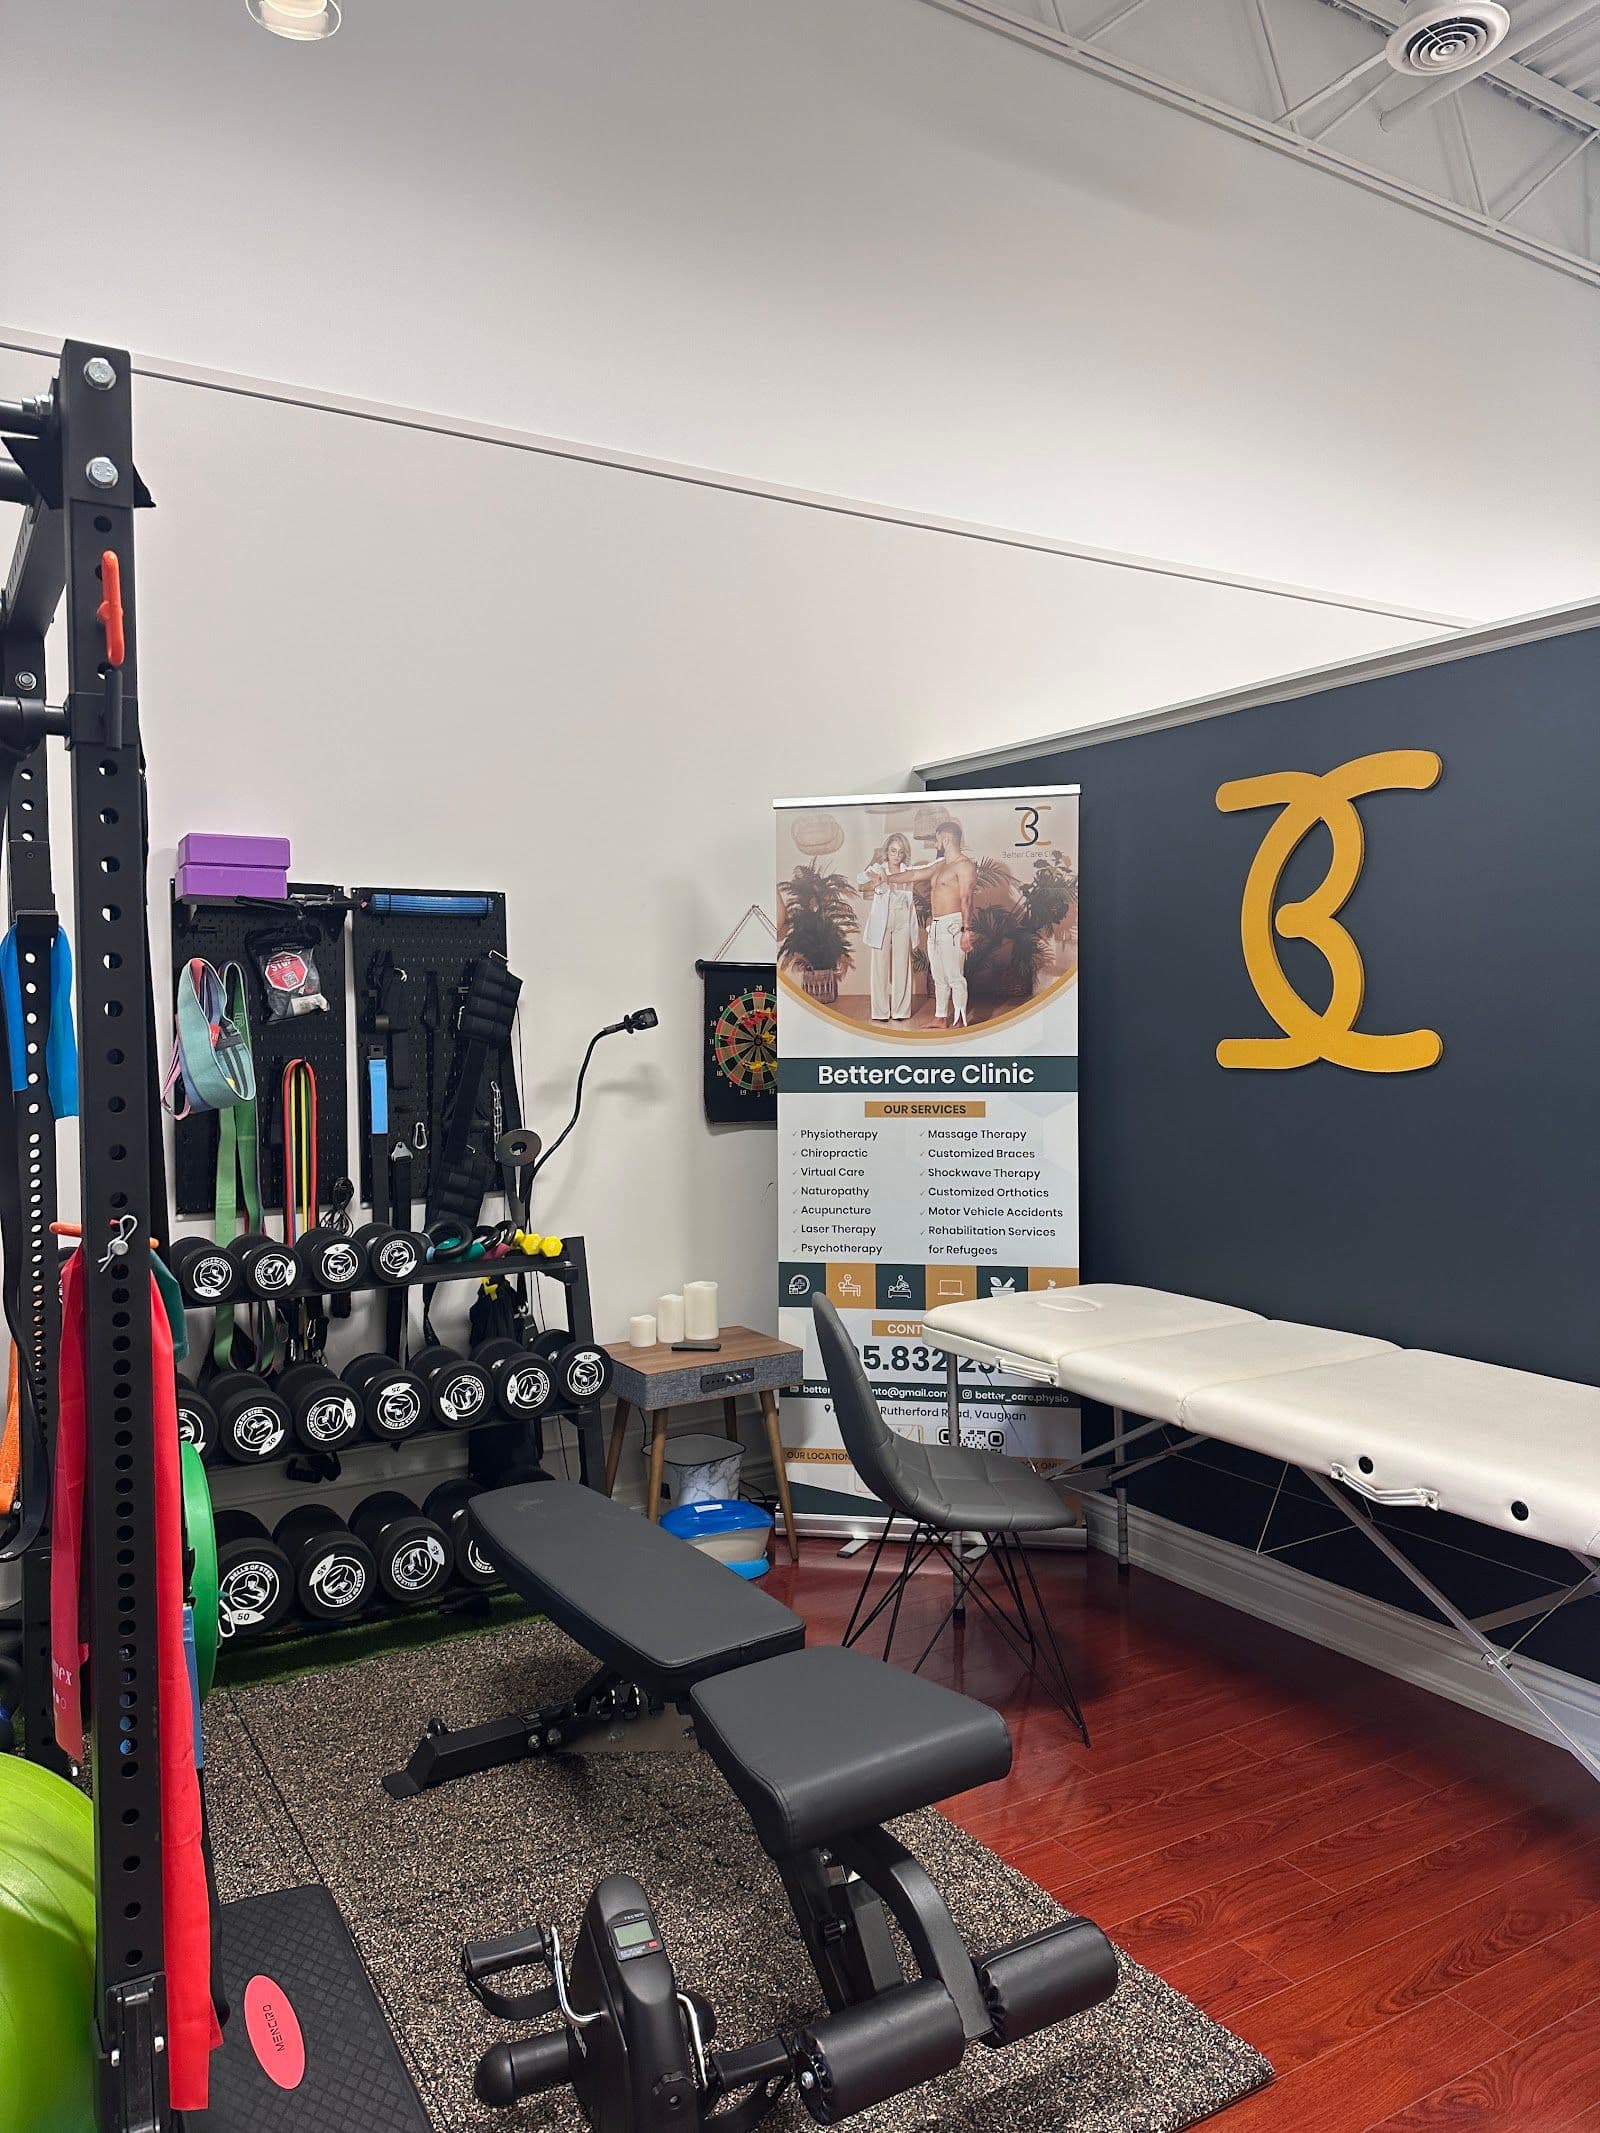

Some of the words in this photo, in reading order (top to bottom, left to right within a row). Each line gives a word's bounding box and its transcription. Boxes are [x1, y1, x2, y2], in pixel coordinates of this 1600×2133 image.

[818, 1064, 956, 1085] BetterCare
[962, 1062, 1035, 1084] Clinic
[883, 1104, 908, 1114] OUR
[911, 1104, 967, 1114] SERVICES
[800, 1129, 878, 1141] Physiotherapy
[928, 1129, 978, 1141] Massage
[980, 1129, 1027, 1141] Therapy
[800, 1148, 868, 1160] Chiropractic
[928, 1148, 994, 1158] Customized
[996, 1149, 1035, 1159] Braces
[800, 1167, 836, 1177] Virtual
[838, 1168, 865, 1177] Care
[928, 1168, 992, 1178] Shockwave
[994, 1168, 1040, 1181] Therapy
[801, 1186, 869, 1198] Naturopathy
[928, 1187, 994, 1197] Customized
[996, 1188, 1049, 1198] Orthotics
[801, 1205, 872, 1217] Acupuncture
[928, 1206, 960, 1216] Motor
[963, 1206, 1004, 1216] Vehicle
[1006, 1207, 1063, 1217] Accidents
[801, 1224, 830, 1234] Laser
[832, 1224, 876, 1237] Therapy
[928, 1225, 1006, 1236] Rehabilitation
[1008, 1227, 1056, 1237] Services
[801, 1243, 883, 1256] Psychotherapy
[928, 1244, 944, 1254] for
[946, 1245, 998, 1258] Refugees
[975, 1390, 1069, 1404] better_care.physio
[880, 1405, 940, 1417] Rutherford
[974, 1408, 1027, 1423] Vaughan
[787, 1451, 806, 1459] OUR
[229, 1565, 249, 1581] BELLS
[258, 1565, 275, 1582] STEEL
[237, 1612, 250, 1621] 50
